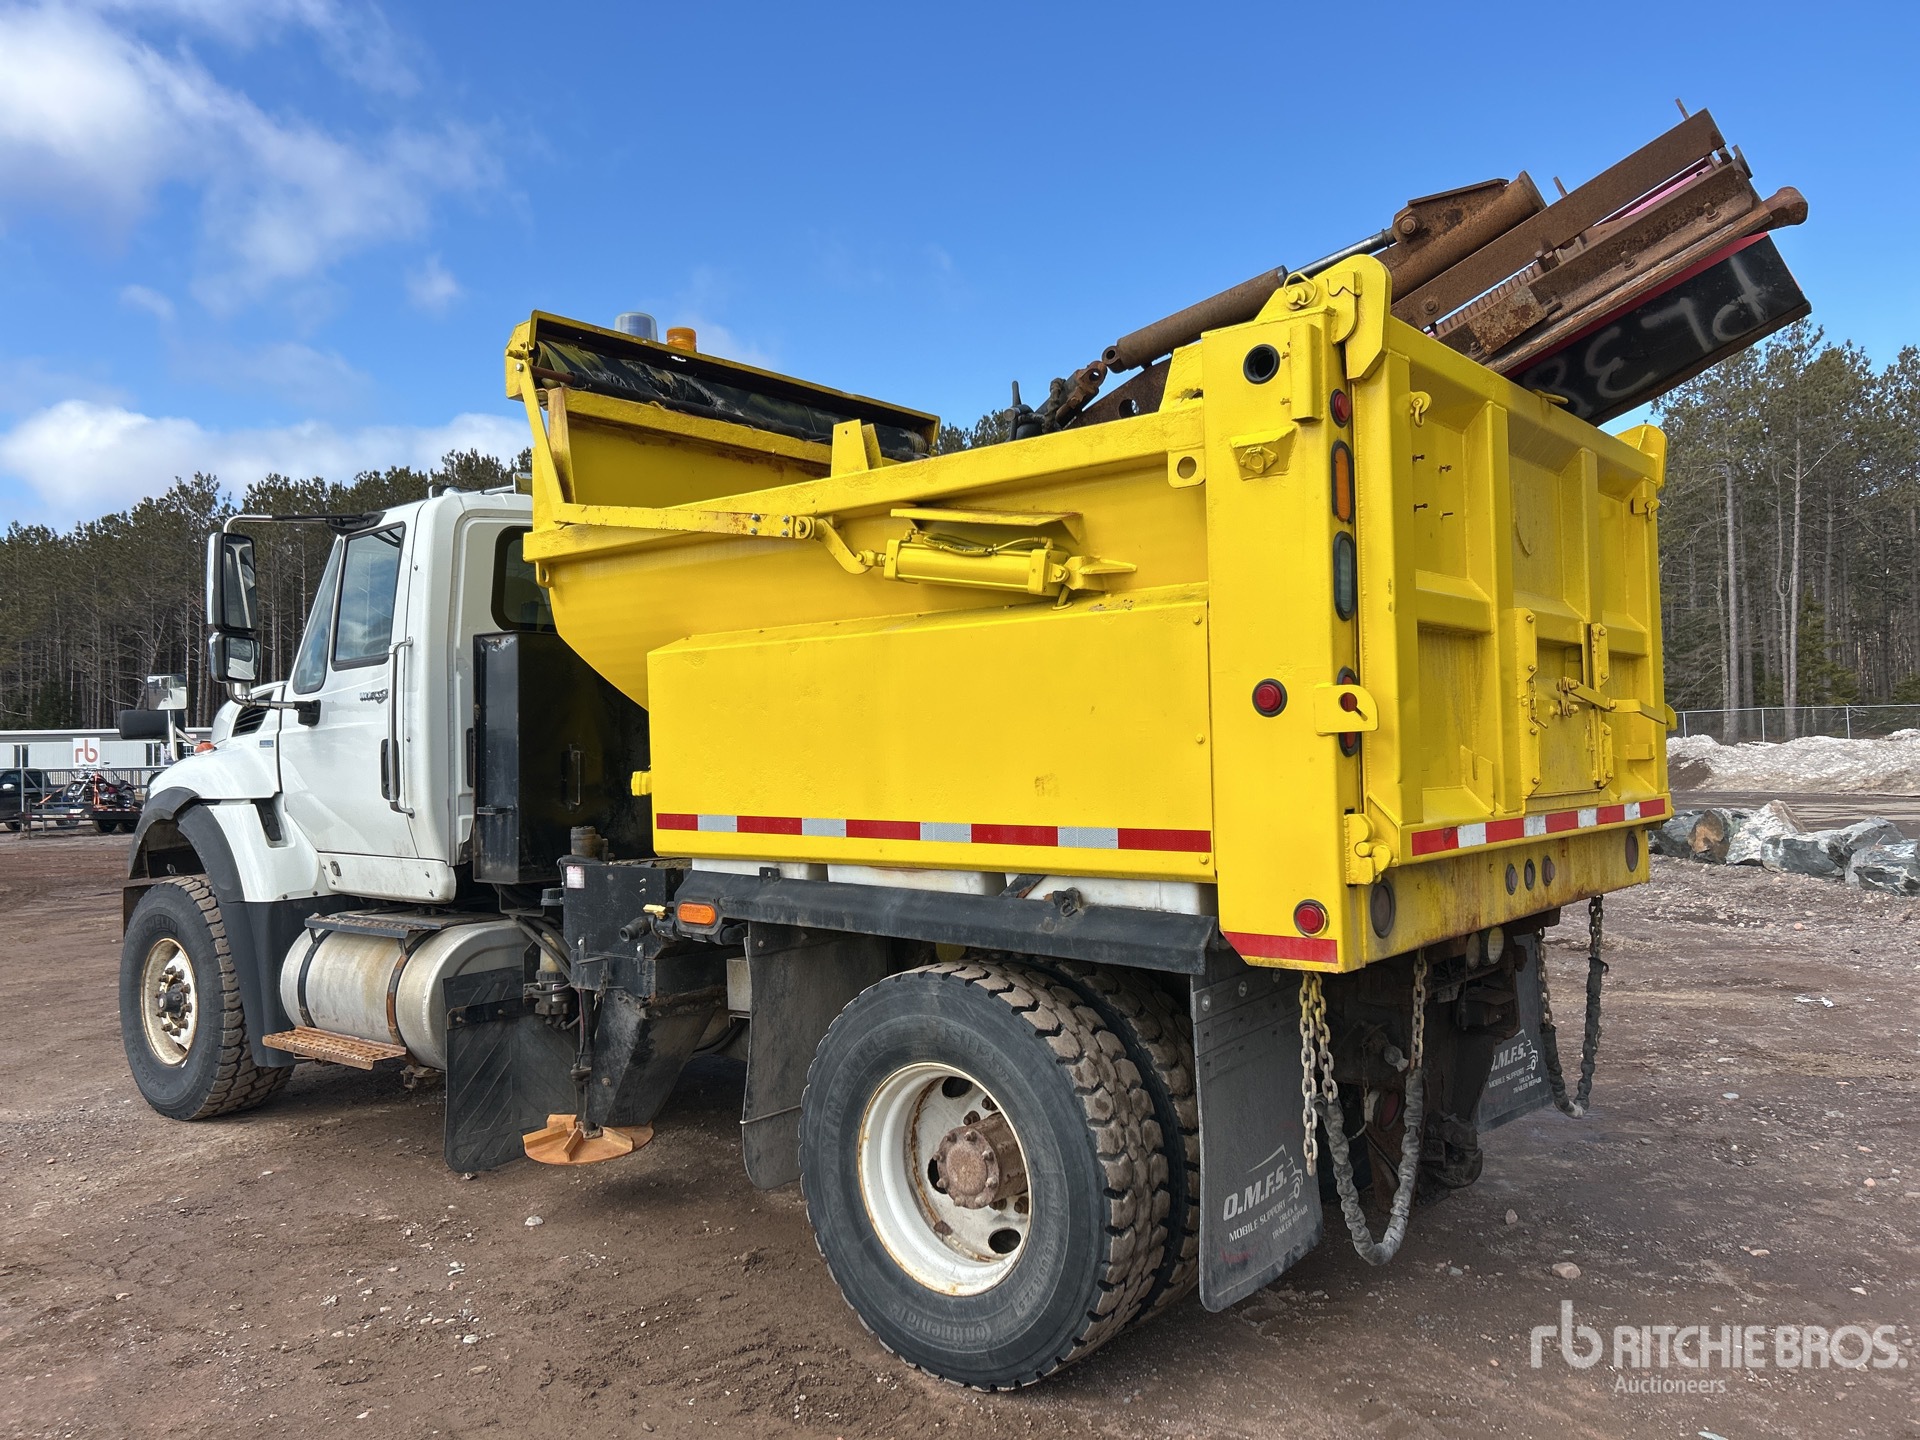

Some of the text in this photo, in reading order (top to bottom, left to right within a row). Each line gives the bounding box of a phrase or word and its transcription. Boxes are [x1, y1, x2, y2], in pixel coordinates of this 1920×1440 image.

[75, 739, 99, 763] rb
[1228, 1200, 1287, 1243] MOBILE SUPPORT
[1271, 1203, 1309, 1240] TRAILER REPAIR
[1278, 1207, 1295, 1223] TRUCK
